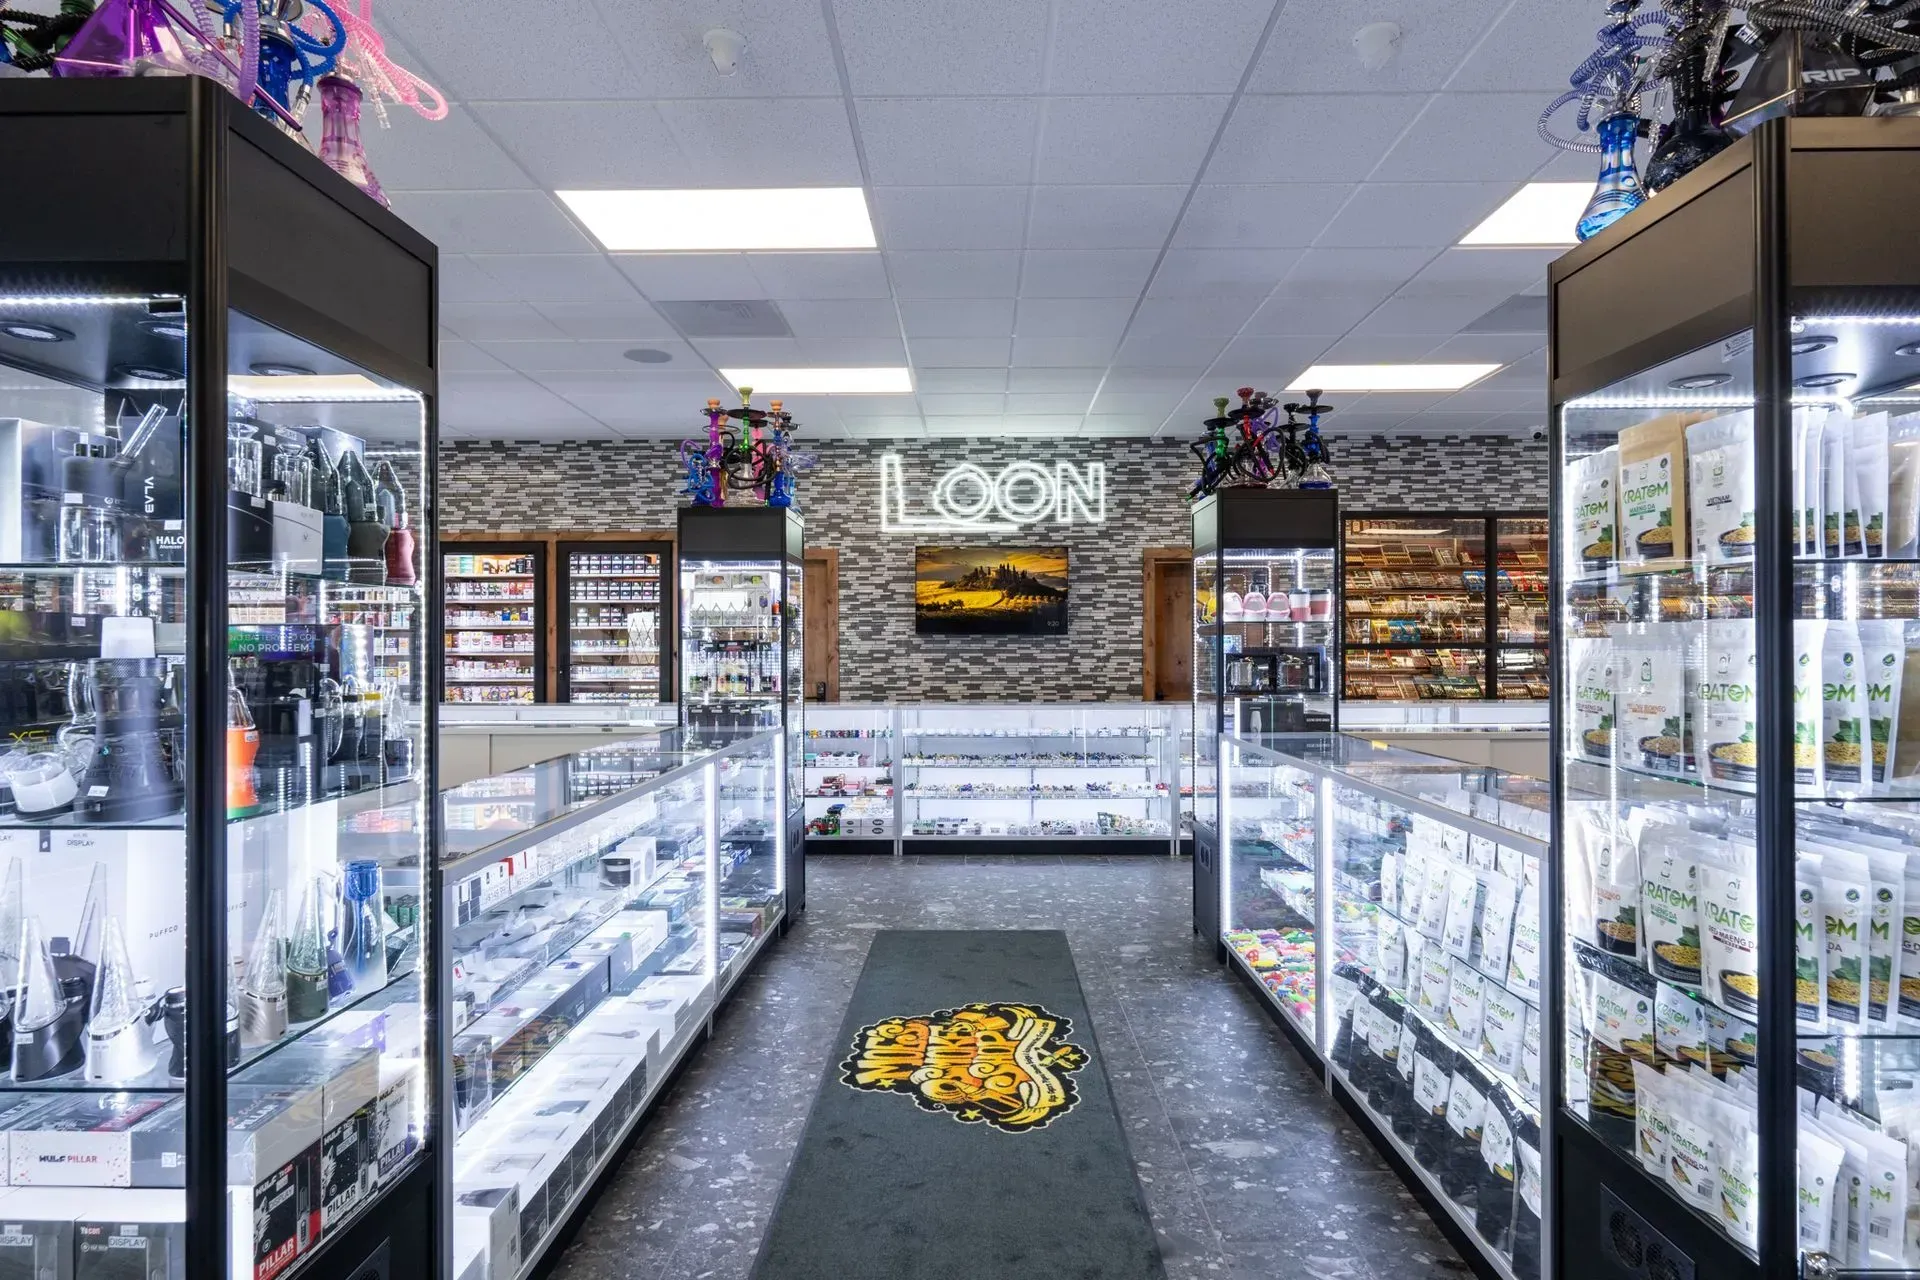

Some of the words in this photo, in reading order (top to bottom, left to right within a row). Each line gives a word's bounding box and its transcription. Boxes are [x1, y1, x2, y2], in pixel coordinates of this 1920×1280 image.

[1801, 68, 1861, 83] RIP
[880, 453, 1105, 532] LOON
[156, 536, 185, 545] HALO
[239, 644, 255, 652] NO
[67, 839, 95, 847] DISPLAY
[228, 901, 248, 913] UFFCO
[1704, 900, 1756, 933] KRATO
[149, 924, 179, 939] PUFFCO
[1719, 931, 1747, 946] MAENG
[968, 1030, 1030, 1095] SHOP
[1671, 1130, 1709, 1161] KRATOM
[67, 1154, 98, 1164] PILLAR
[326, 1184, 357, 1218] PILLAR
[108, 1237, 147, 1248] DISPLAY
[258, 1238, 295, 1278] PILLAR
